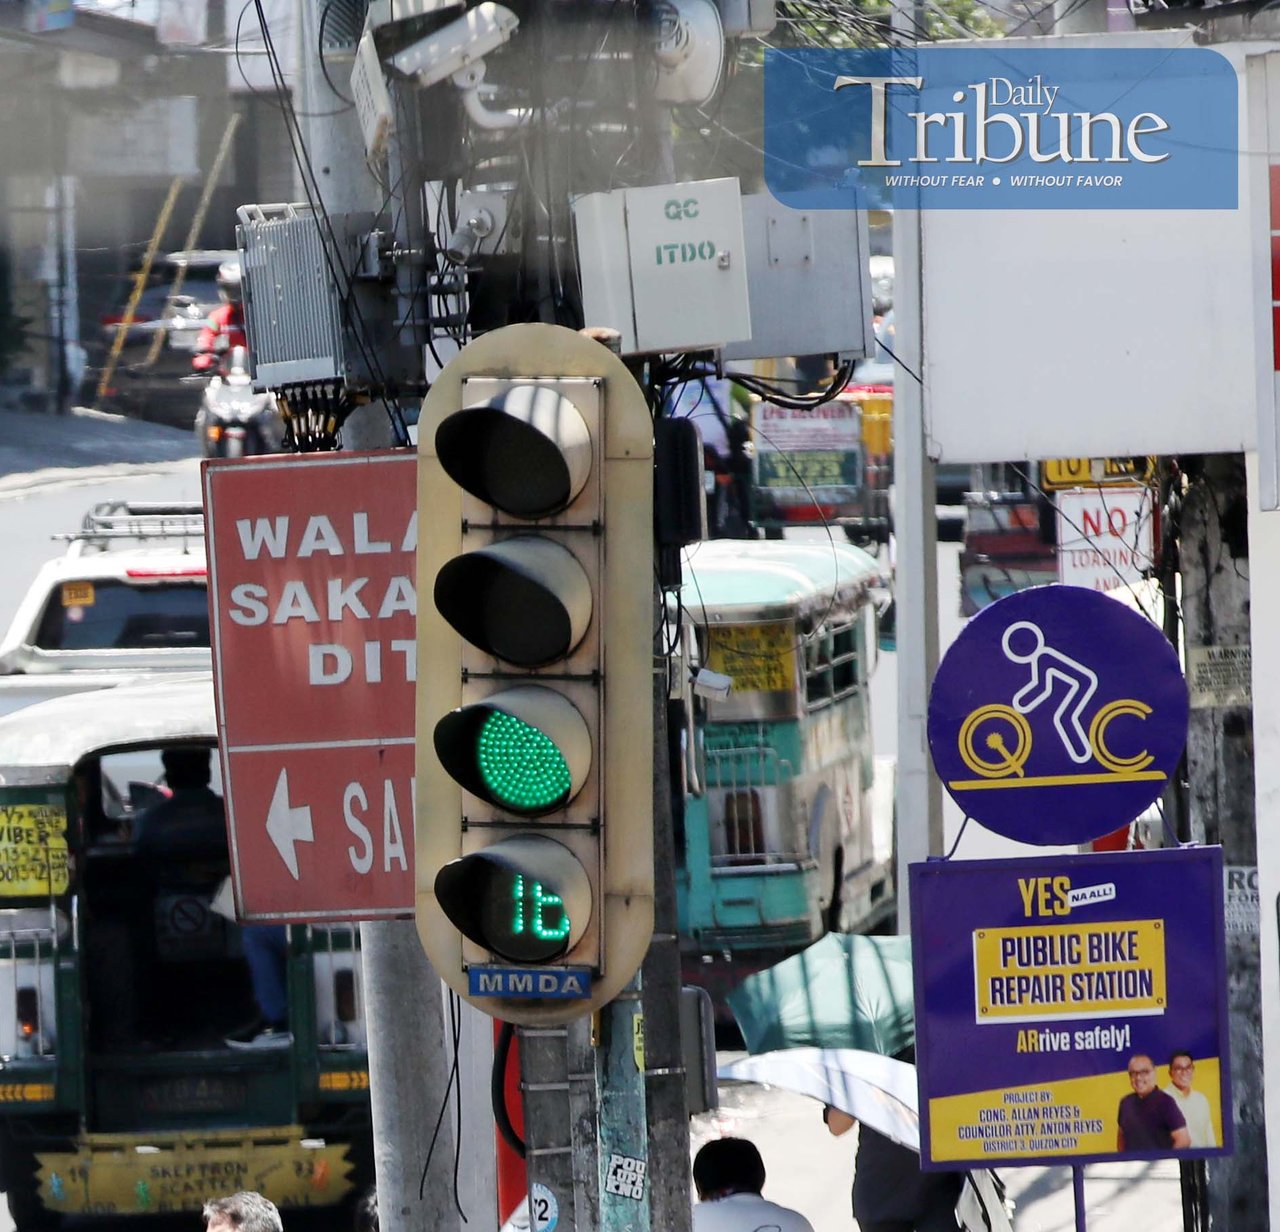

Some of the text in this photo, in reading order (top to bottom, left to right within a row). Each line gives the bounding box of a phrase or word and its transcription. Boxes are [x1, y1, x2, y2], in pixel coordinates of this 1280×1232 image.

[664, 198, 700, 220] QC
[656, 241, 716, 265] ITDO
[1081, 507, 1128, 538] NO
[958, 699, 1154, 778] QC
[343, 777, 416, 875] SA
[1018, 875, 1071, 918] YES
[1000, 930, 1139, 970] PUBLIC BIKE
[480, 973, 582, 993] MMDA
[990, 968, 1153, 1006] REPAIR STATION
[1016, 1023, 1132, 1054] ARrive safely!
[1012, 1107, 1040, 1122] ALLAN
[1042, 1105, 1072, 1119] REYES
[958, 1124, 1013, 1140] COUNCILOR
[1040, 1120, 1072, 1135] ANTON
[1074, 1119, 1103, 1134] REYES
[1029, 1138, 1060, 1151] QUEZON
